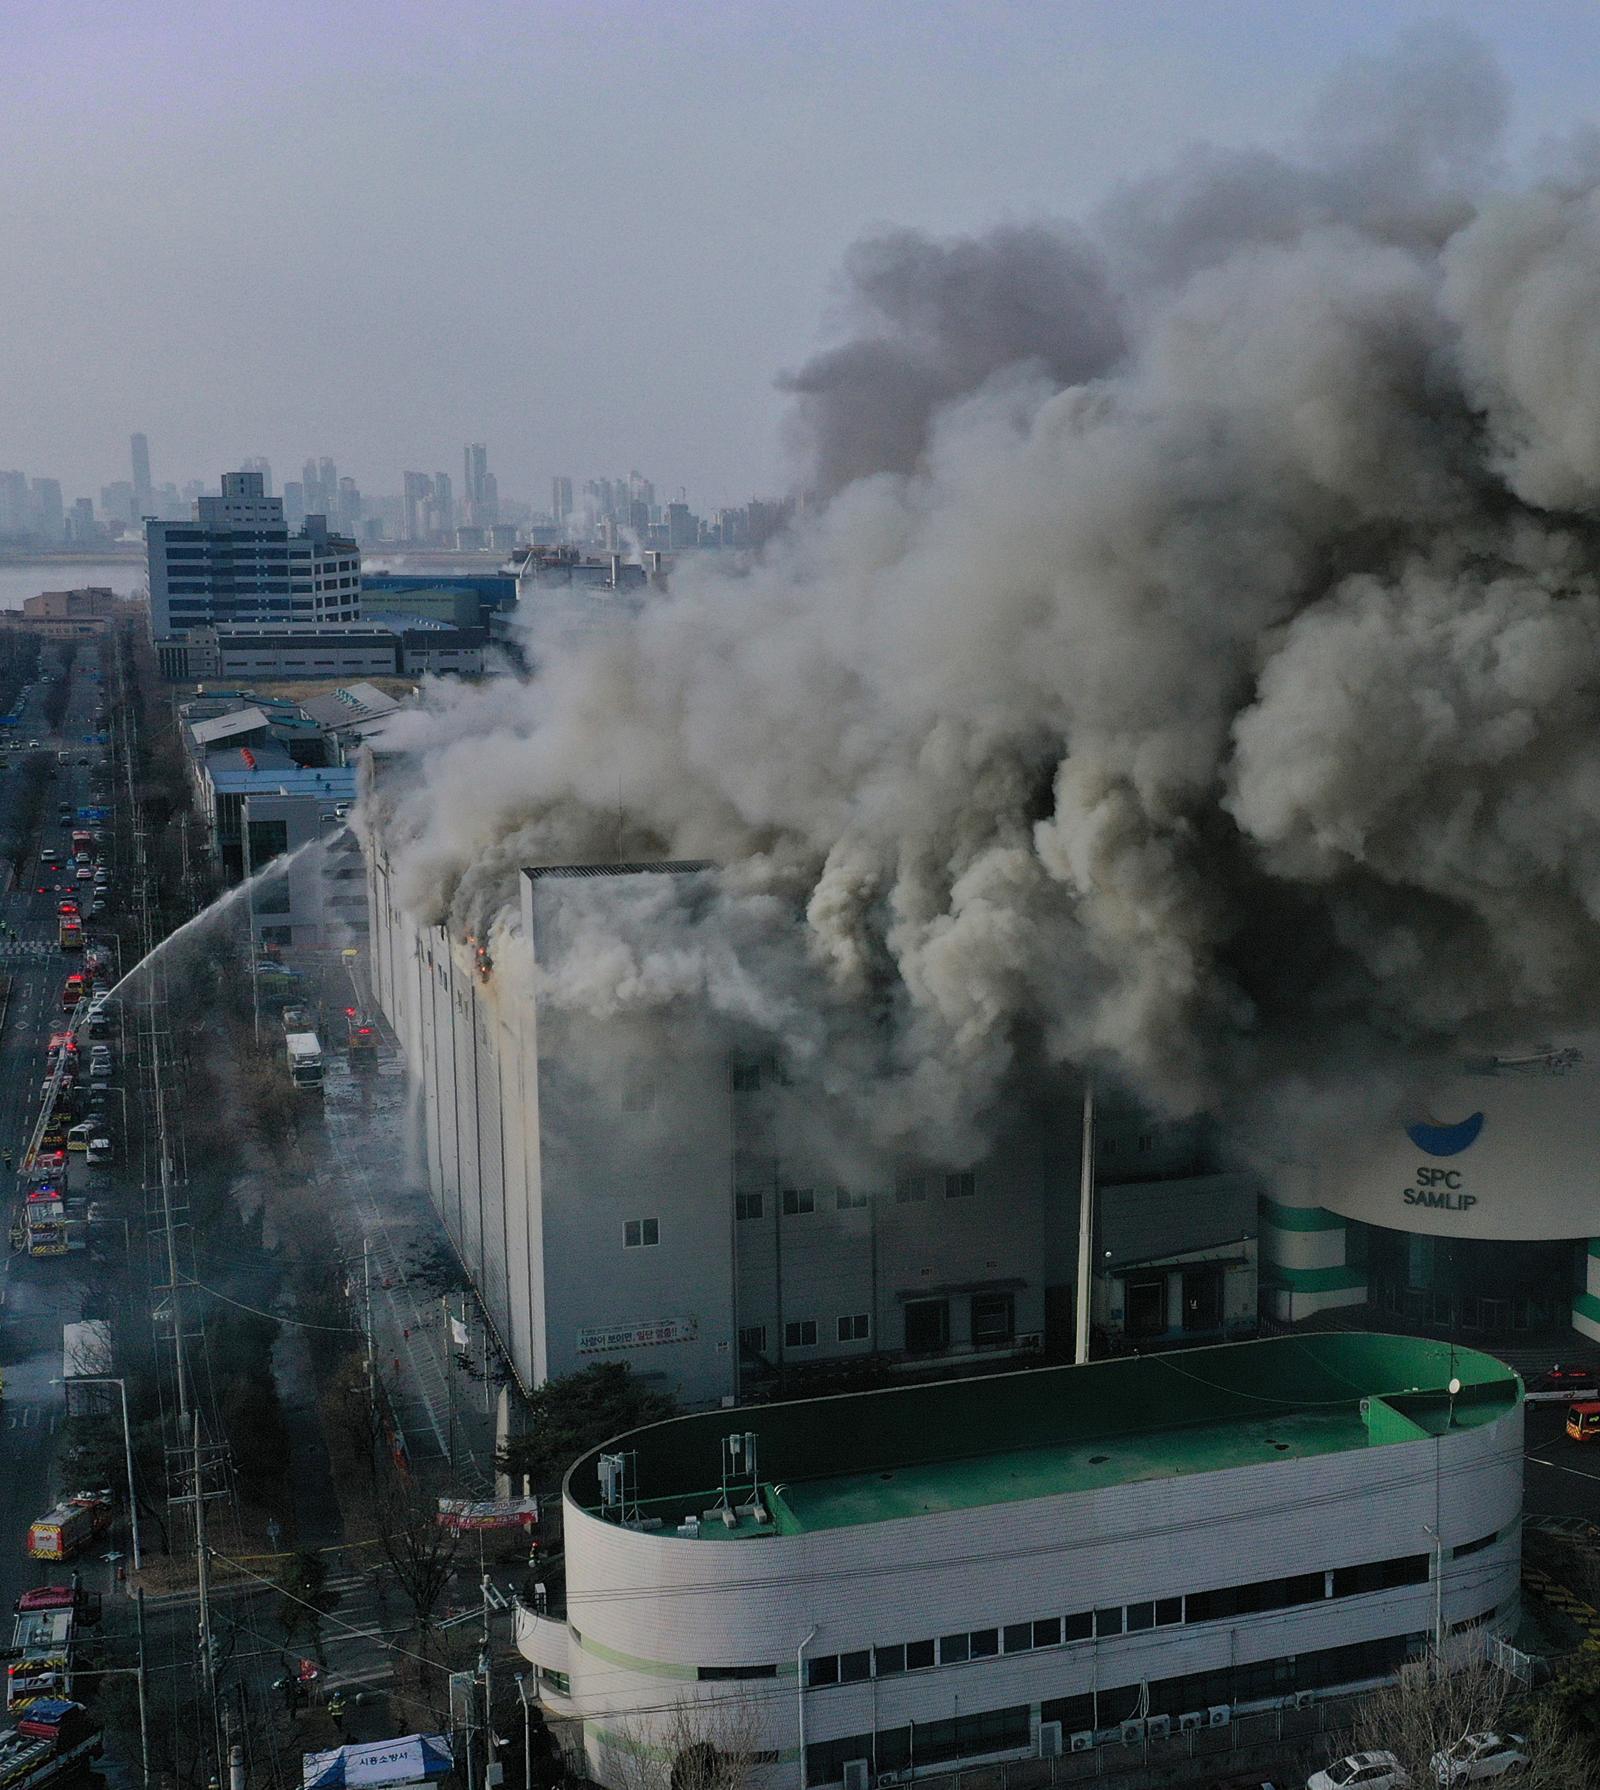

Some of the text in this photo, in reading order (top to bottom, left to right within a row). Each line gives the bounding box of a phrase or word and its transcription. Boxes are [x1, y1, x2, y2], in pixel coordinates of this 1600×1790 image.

[1416, 1167, 1462, 1190] SPC
[1403, 1188, 1477, 1211] SAMLIP
[359, 1751, 409, 1766] 시흥소방서
